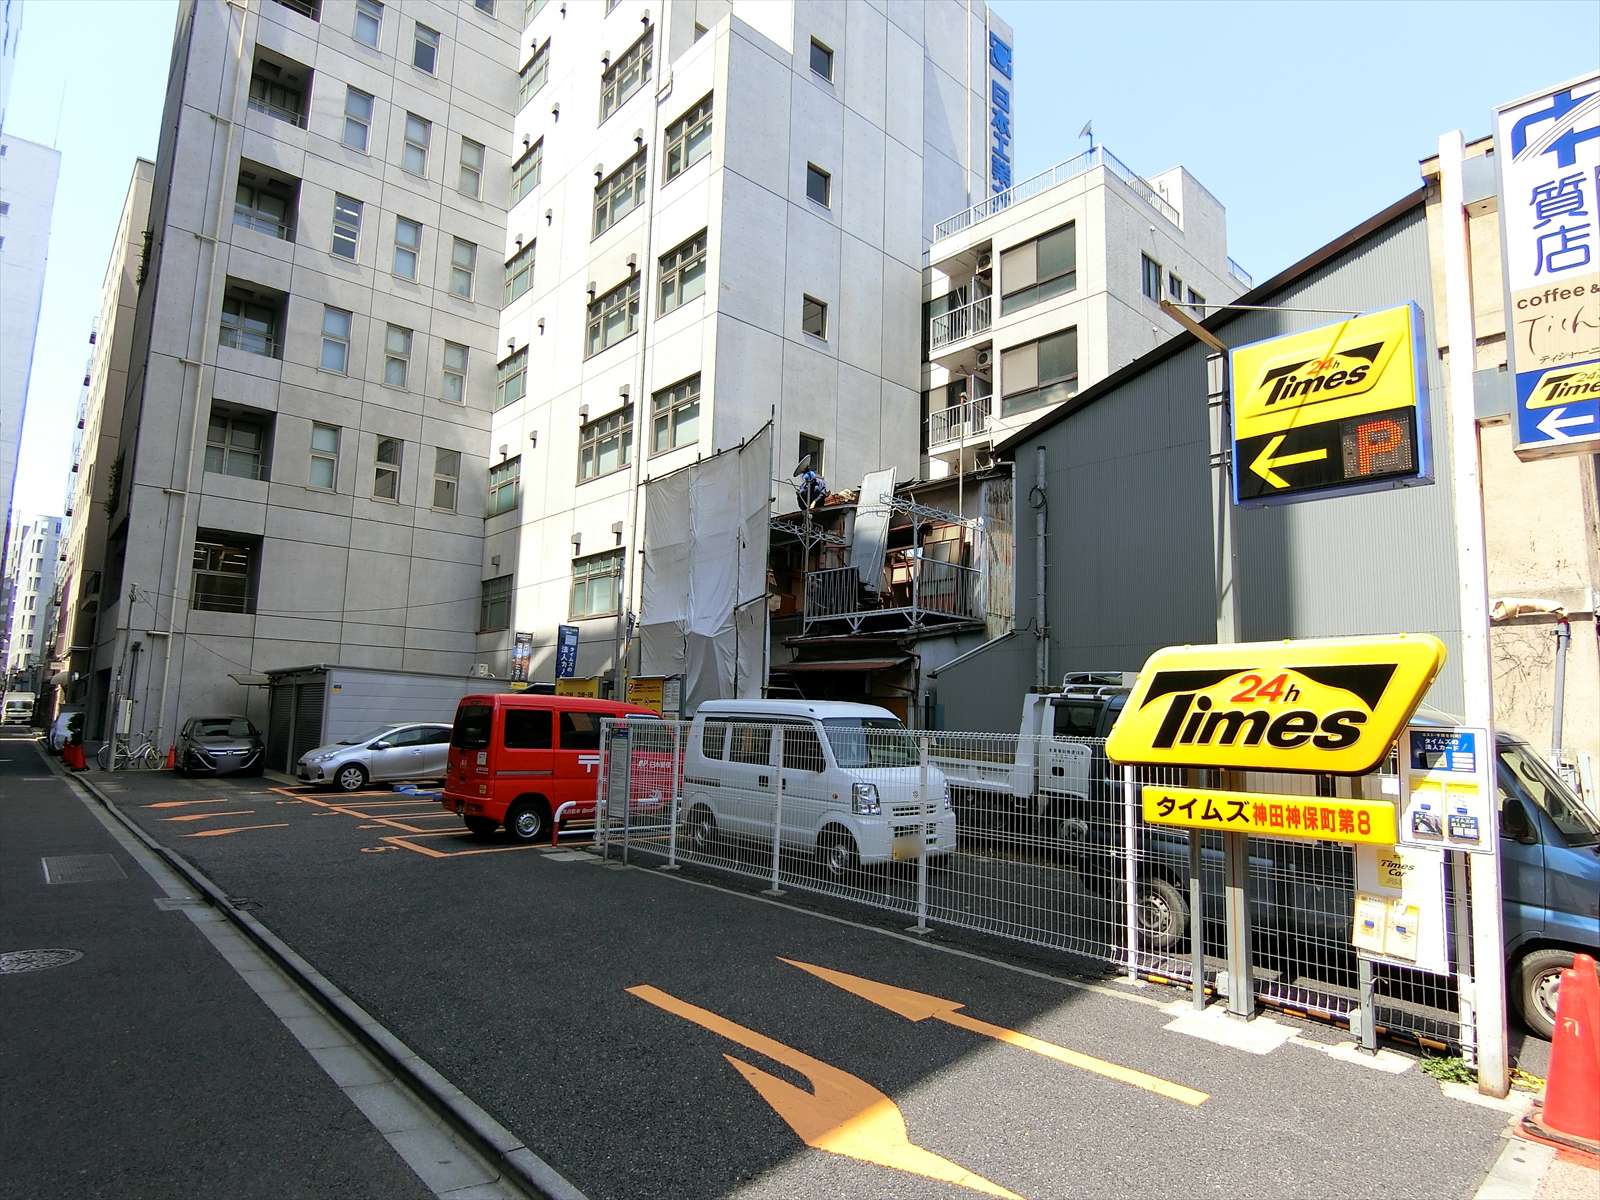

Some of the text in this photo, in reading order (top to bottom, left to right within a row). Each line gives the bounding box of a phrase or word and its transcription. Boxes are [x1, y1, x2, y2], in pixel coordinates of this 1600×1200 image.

[1529, 171, 1591, 276] 質店
[1517, 283, 1600, 310] coffee &
[1306, 357, 1340, 376] 24h
[1264, 364, 1370, 407] Times
[1357, 419, 1403, 476] P
[559, 645, 569, 678] 法人カー
[1229, 673, 1300, 703] 24h
[1151, 692, 1368, 751] Times
[1424, 738, 1459, 746] タイムズの
[1156, 796, 1371, 835] タイムズ神田神保町第8
[1381, 859, 1415, 871] Times
